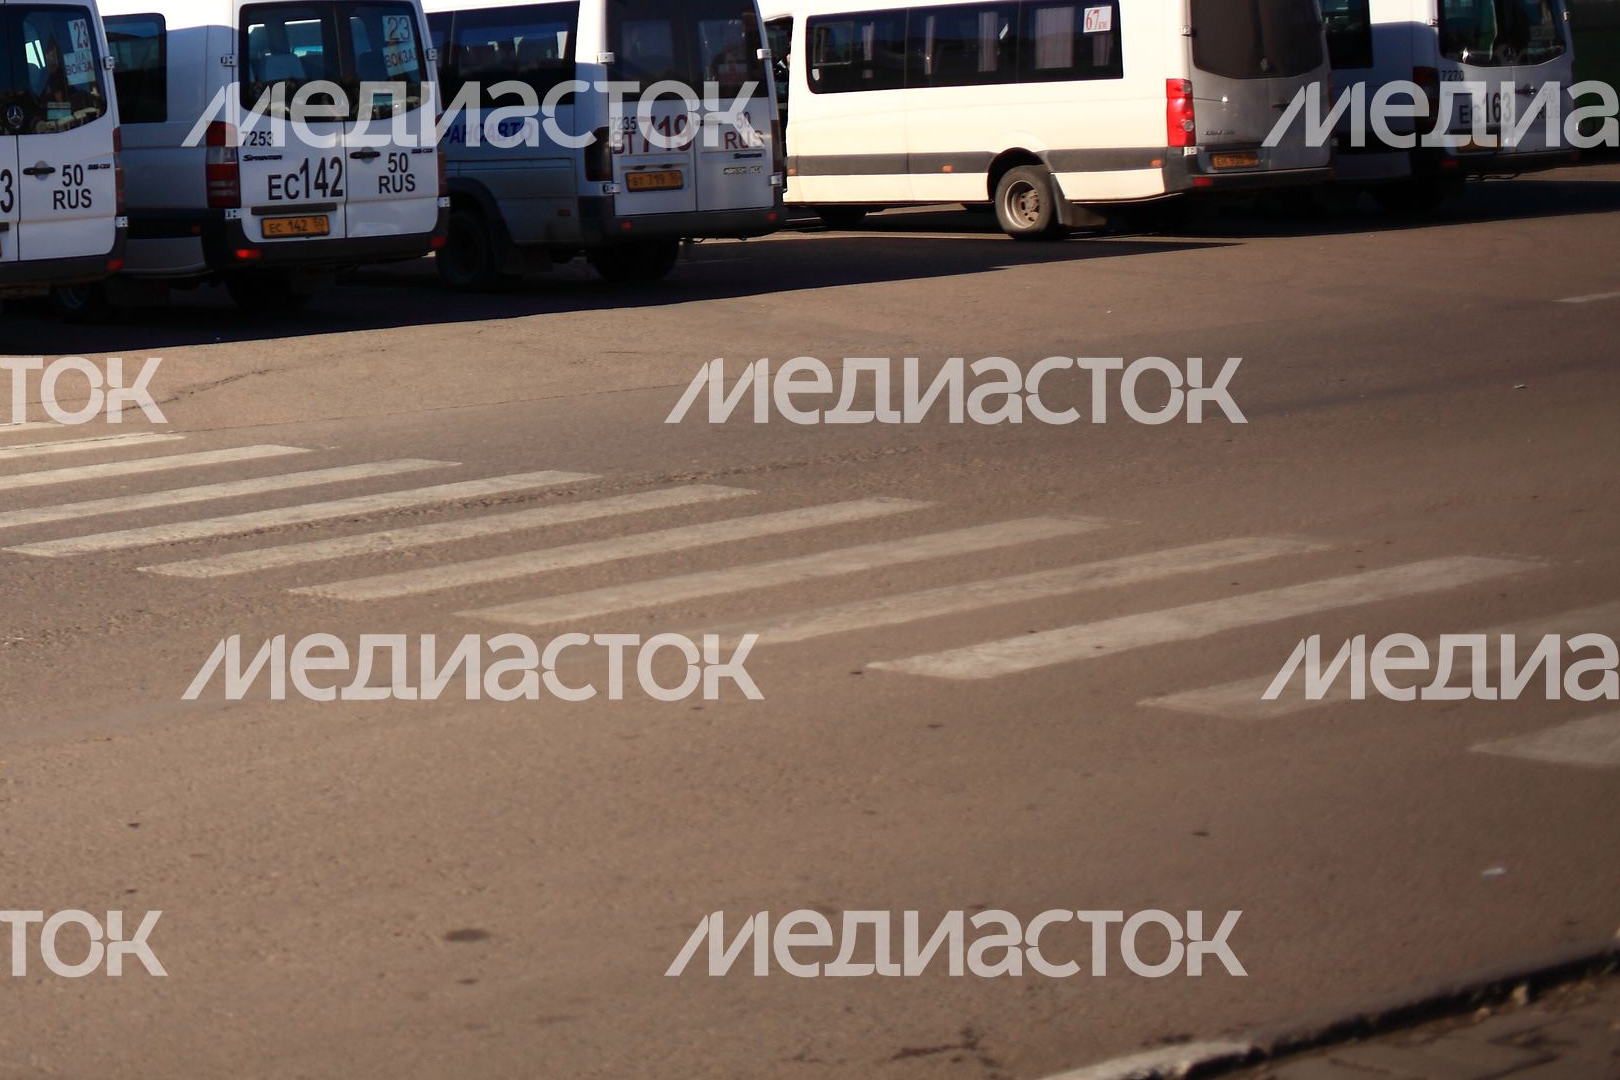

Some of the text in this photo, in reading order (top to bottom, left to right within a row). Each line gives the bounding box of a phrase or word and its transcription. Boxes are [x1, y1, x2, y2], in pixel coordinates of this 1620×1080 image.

[387, 16, 410, 41] 23
[387, 152, 409, 174] 50
[62, 163, 84, 188] 50
[378, 173, 416, 195] RUS
[53, 188, 93, 211] RUS
[288, 219, 308, 232] 142
